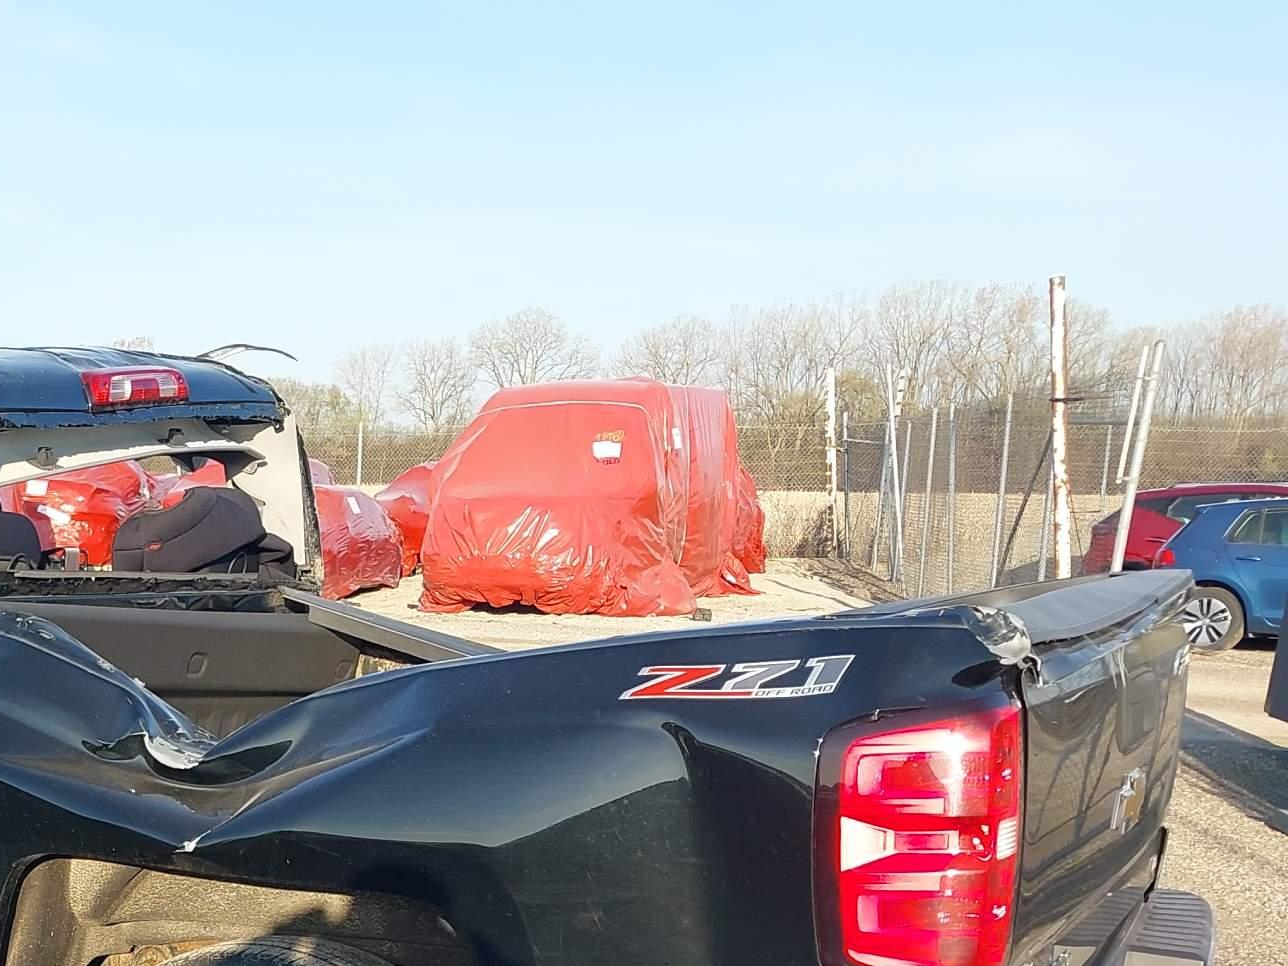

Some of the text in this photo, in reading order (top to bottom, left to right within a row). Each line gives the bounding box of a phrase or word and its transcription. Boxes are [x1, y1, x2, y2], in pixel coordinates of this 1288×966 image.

[619, 654, 856, 700] Z71
[754, 684, 834, 698] OFF ROAD
